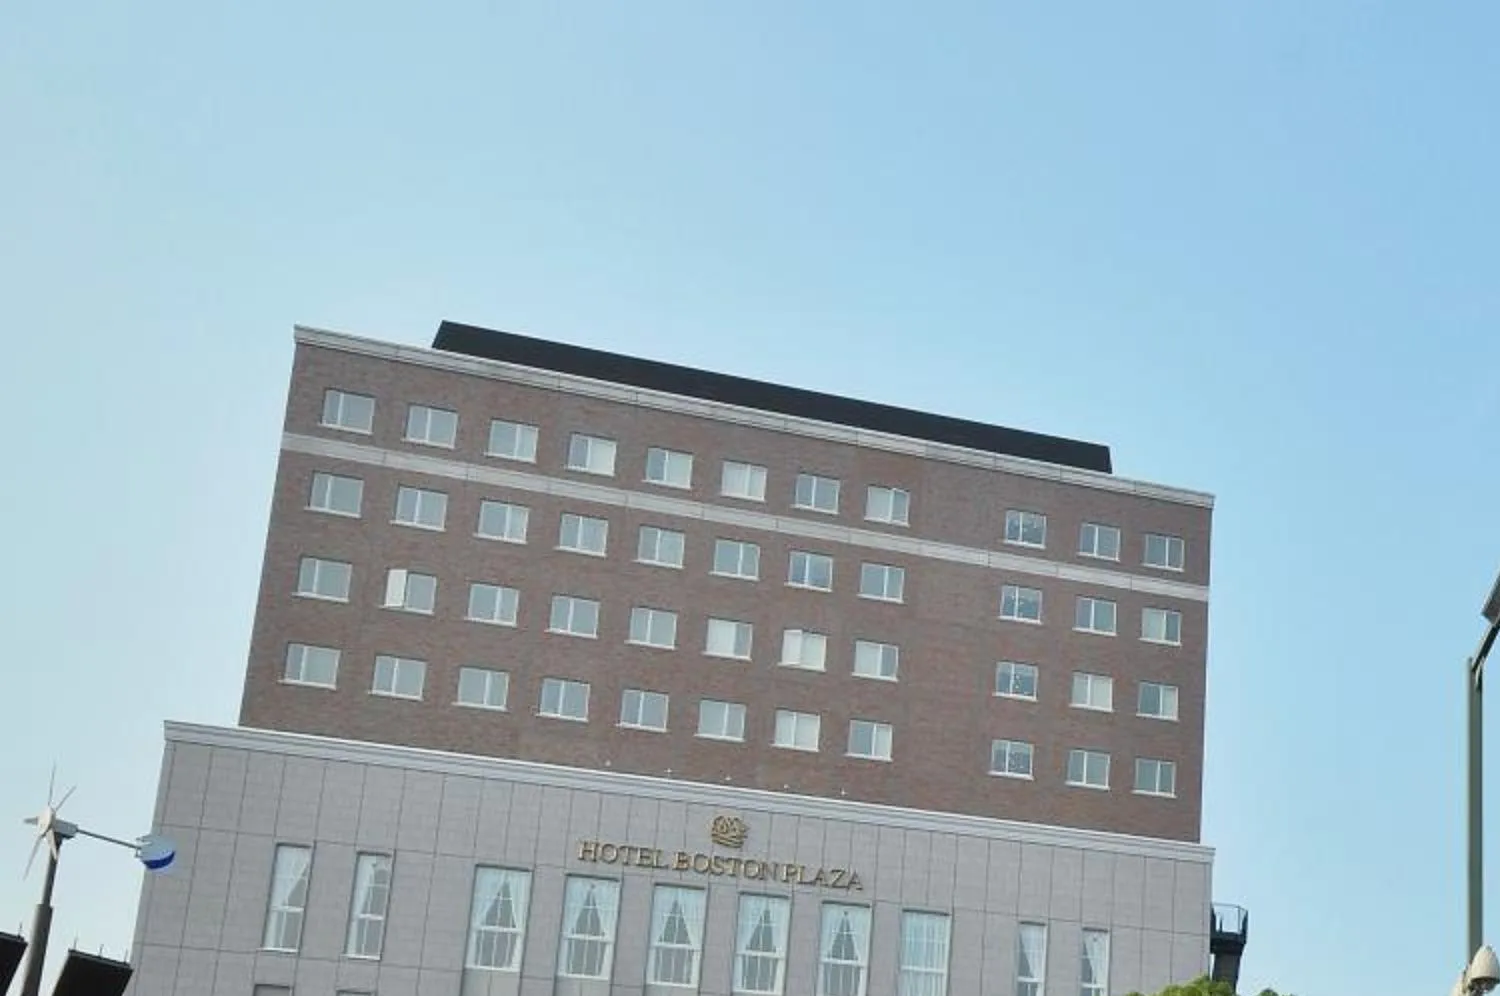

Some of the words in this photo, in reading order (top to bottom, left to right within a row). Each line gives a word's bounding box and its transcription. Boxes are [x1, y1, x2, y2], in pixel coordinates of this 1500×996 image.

[578, 839, 669, 870] HOTEL
[675, 851, 779, 882] BOSTON
[782, 863, 863, 891] PLAZA
